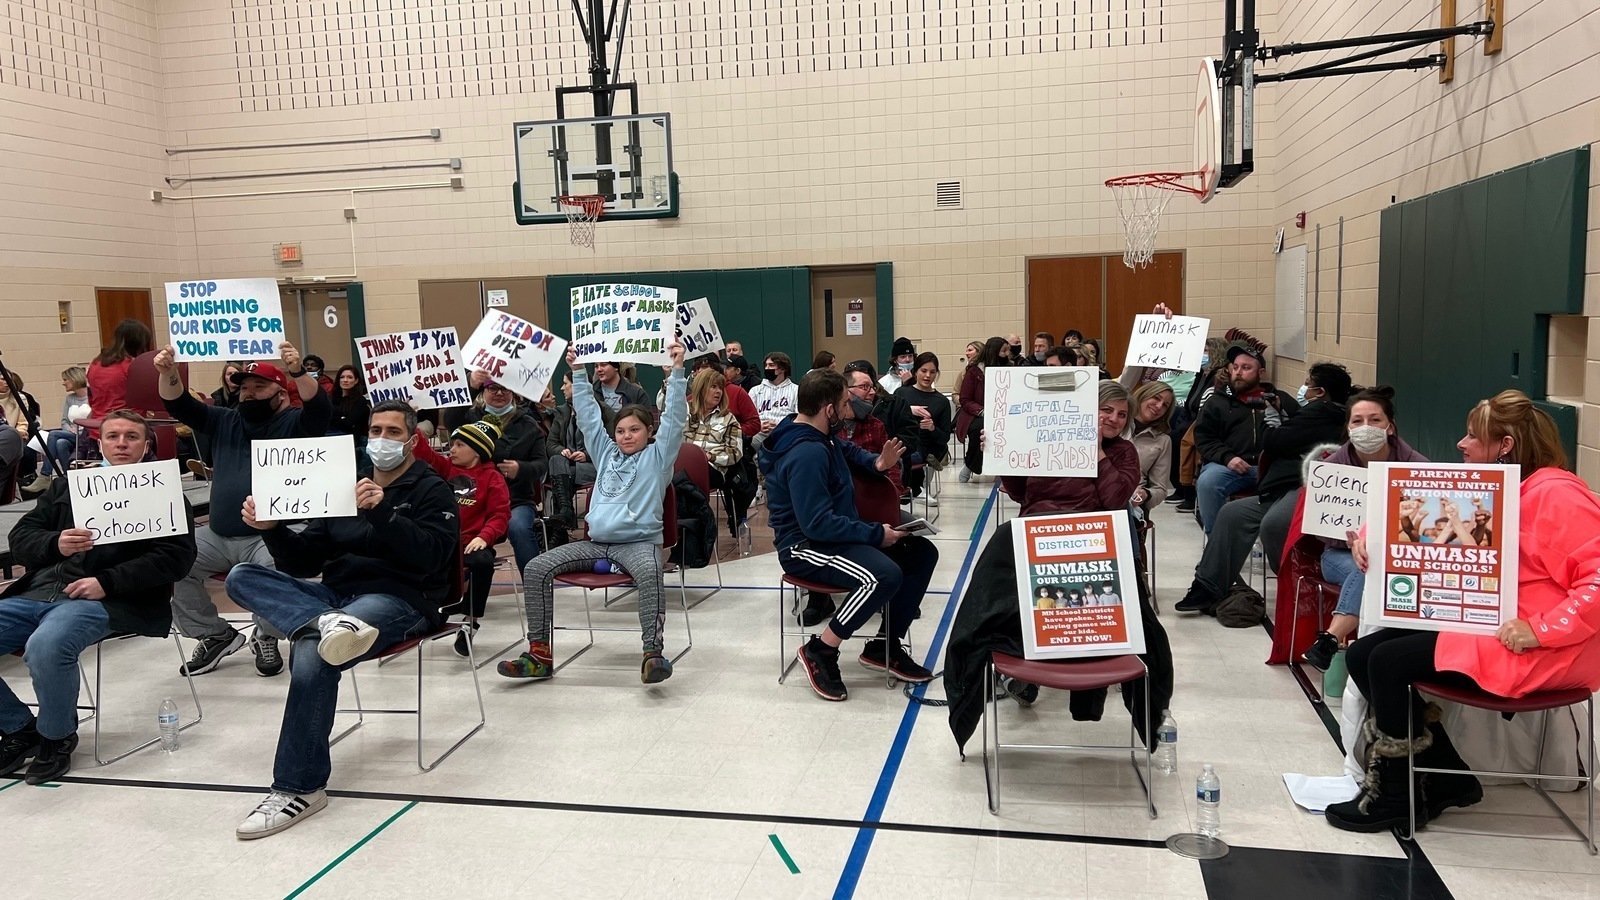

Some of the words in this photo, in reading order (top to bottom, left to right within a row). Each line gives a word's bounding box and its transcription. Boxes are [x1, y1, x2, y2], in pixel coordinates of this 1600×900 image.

[180, 281, 217, 298] STOP
[572, 289, 579, 307] I
[582, 284, 611, 304] HATE
[613, 284, 661, 298] SCHOOL
[168, 299, 259, 318] PUNISHING
[323, 305, 338, 328] 6
[573, 302, 618, 324] BECAUSE
[621, 301, 636, 313] OF
[636, 300, 675, 314] MASKS
[170, 320, 199, 335] OUR
[202, 318, 242, 334] KIDS
[248, 317, 282, 333] FOR
[575, 320, 599, 341] HELP
[601, 318, 620, 334] ME
[626, 318, 661, 332] LOVE
[176, 340, 218, 356] YOUR
[228, 339, 274, 355] FEAR
[360, 334, 405, 358] THANKS
[409, 331, 428, 350] TO
[431, 330, 456, 350] YOU
[491, 334, 526, 359] OVER
[575, 341, 608, 357] SCHOOL
[613, 337, 665, 355] AGAIN!
[363, 361, 389, 385] I'VE
[389, 358, 412, 377] ONLY
[415, 353, 441, 370] HAD
[443, 349, 455, 366] 1
[470, 348, 507, 378] FEAR
[413, 369, 459, 391] SCHOOL
[429, 387, 470, 406] YEAR!
[759, 397, 789, 413] Mets
[1026, 414, 1094, 429] HEALTH
[1037, 427, 1097, 443] MATTERS
[1008, 448, 1040, 469] OUR
[1311, 464, 1368, 494] Scienc
[1410, 470, 1467, 479] PARENTS
[1391, 479, 1454, 489] STUDENTS
[1457, 481, 1500, 491] UNITE!
[1403, 489, 1450, 499] ACTION
[1453, 490, 1489, 500] NOW!
[1030, 523, 1073, 534] ACTION
[1075, 521, 1108, 531] NOW!
[1390, 544, 1498, 565] UNMASK
[1035, 560, 1113, 576] UNMASK
[1392, 559, 1421, 569] OUR
[1424, 561, 1493, 574] SCHOOLS!
[1036, 577, 1059, 585] OUR
[1061, 573, 1114, 584] SCHOOLS!
[1055, 608, 1081, 616] School
[1042, 623, 1071, 631] playing
[1049, 636, 1070, 644] END
[1085, 634, 1112, 642] NOW!
